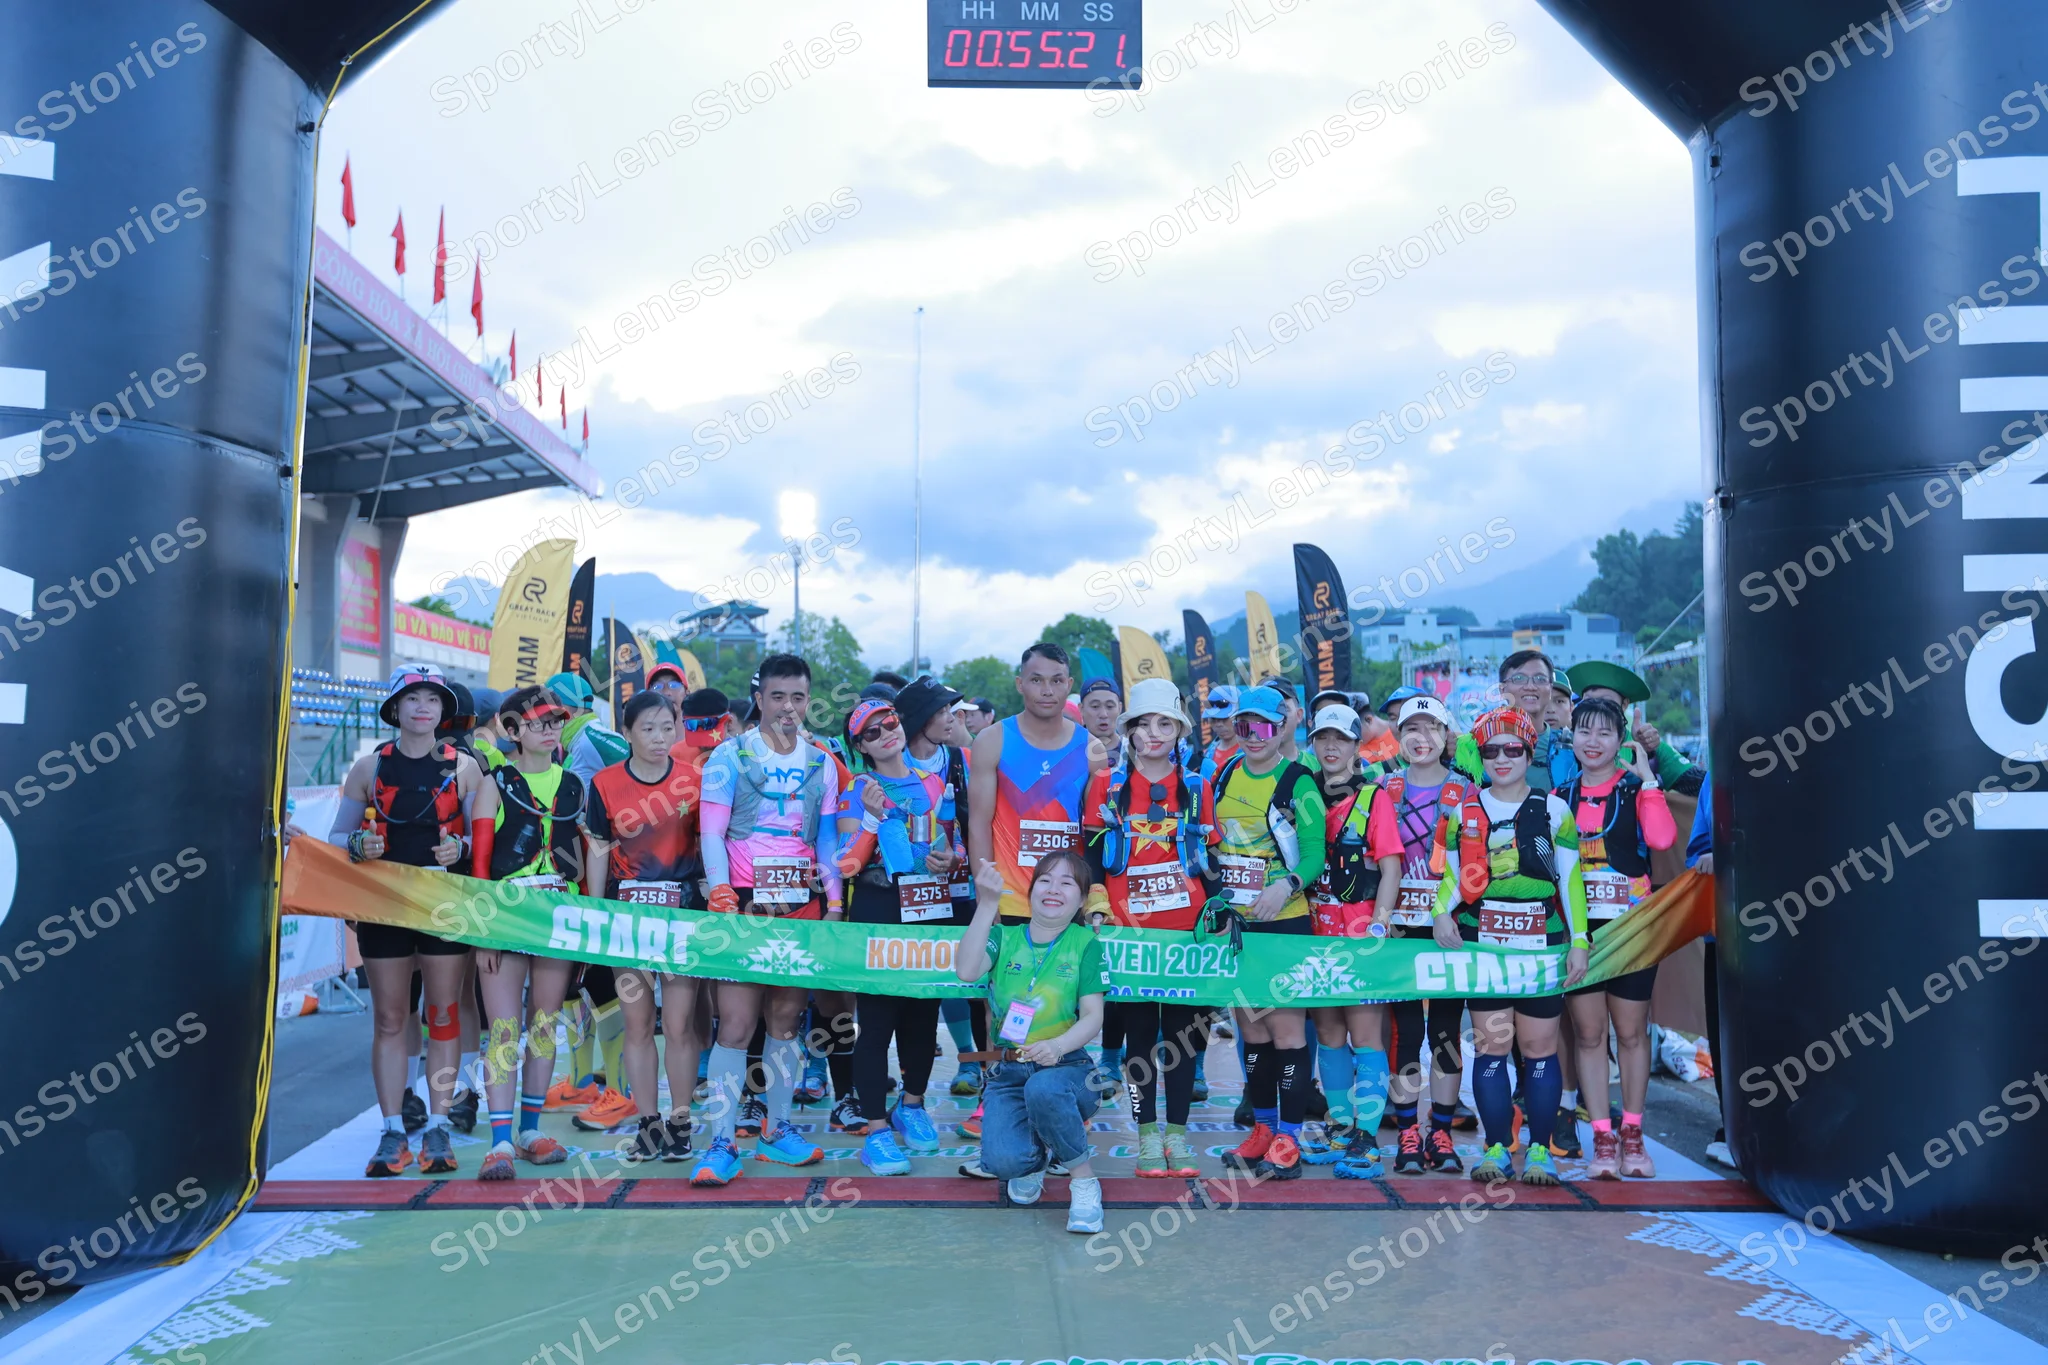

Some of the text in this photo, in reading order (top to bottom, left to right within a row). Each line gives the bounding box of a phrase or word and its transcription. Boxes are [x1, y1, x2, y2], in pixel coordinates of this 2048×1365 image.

[962, 0, 1114, 21] HH MM SS
[509, 603, 556, 617] GREAT RACE
[514, 636, 539, 688] NAM
[1032, 833, 1070, 849] 2506
[1248, 861, 1265, 870] 25KM
[766, 869, 801, 884] 2574
[1137, 875, 1176, 893] 2589
[1221, 868, 1250, 885] 2556
[1611, 875, 1627, 883] 25KM
[629, 890, 667, 904] 2558
[912, 886, 942, 902] 2575
[1586, 884, 1616, 899] 569
[1529, 905, 1545, 914] 25KM
[1493, 914, 1534, 931] 2567
[548, 904, 696, 965] START
[866, 937, 959, 971] KOMO
[1104, 940, 1160, 976] YEN
[1165, 943, 1239, 978] 2024
[1128, 1083, 1142, 1114] RUN
